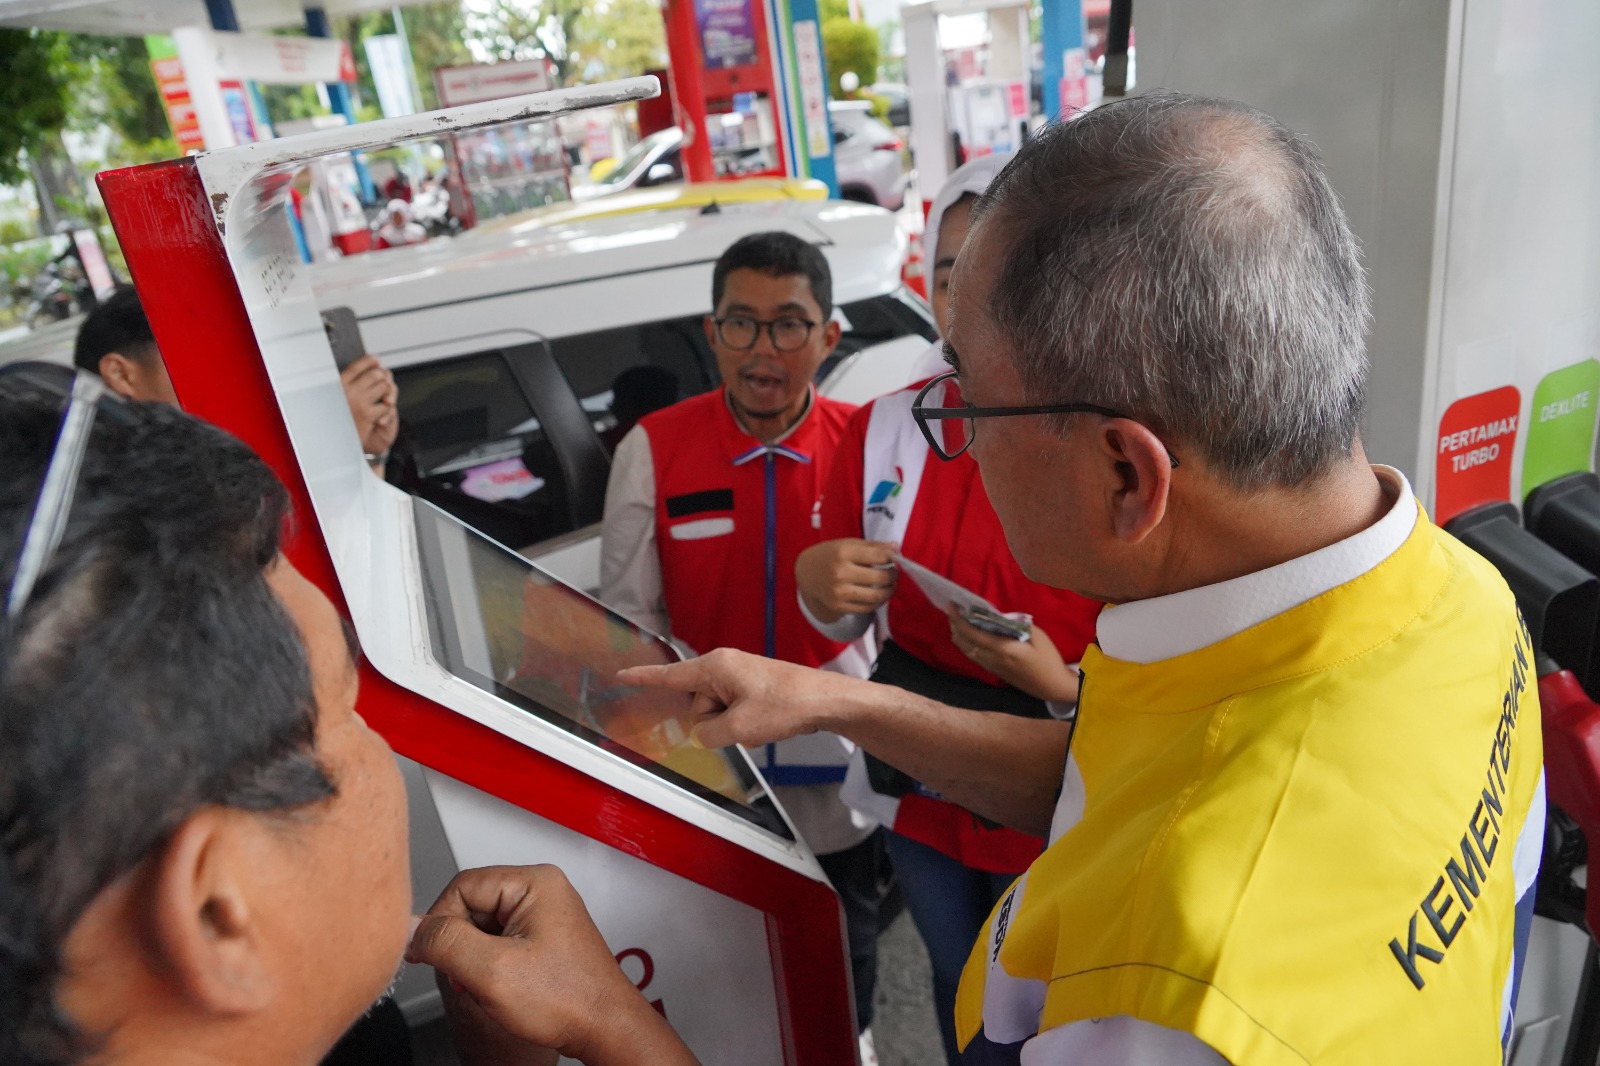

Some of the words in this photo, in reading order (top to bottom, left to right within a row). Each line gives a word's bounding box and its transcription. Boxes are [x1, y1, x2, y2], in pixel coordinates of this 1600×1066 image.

[1540, 391, 1590, 423] DEXLITE
[1439, 415, 1518, 454] PERTAMAX
[1452, 443, 1500, 473] TURBO
[1388, 629, 1528, 991] KEMENTERIAN
